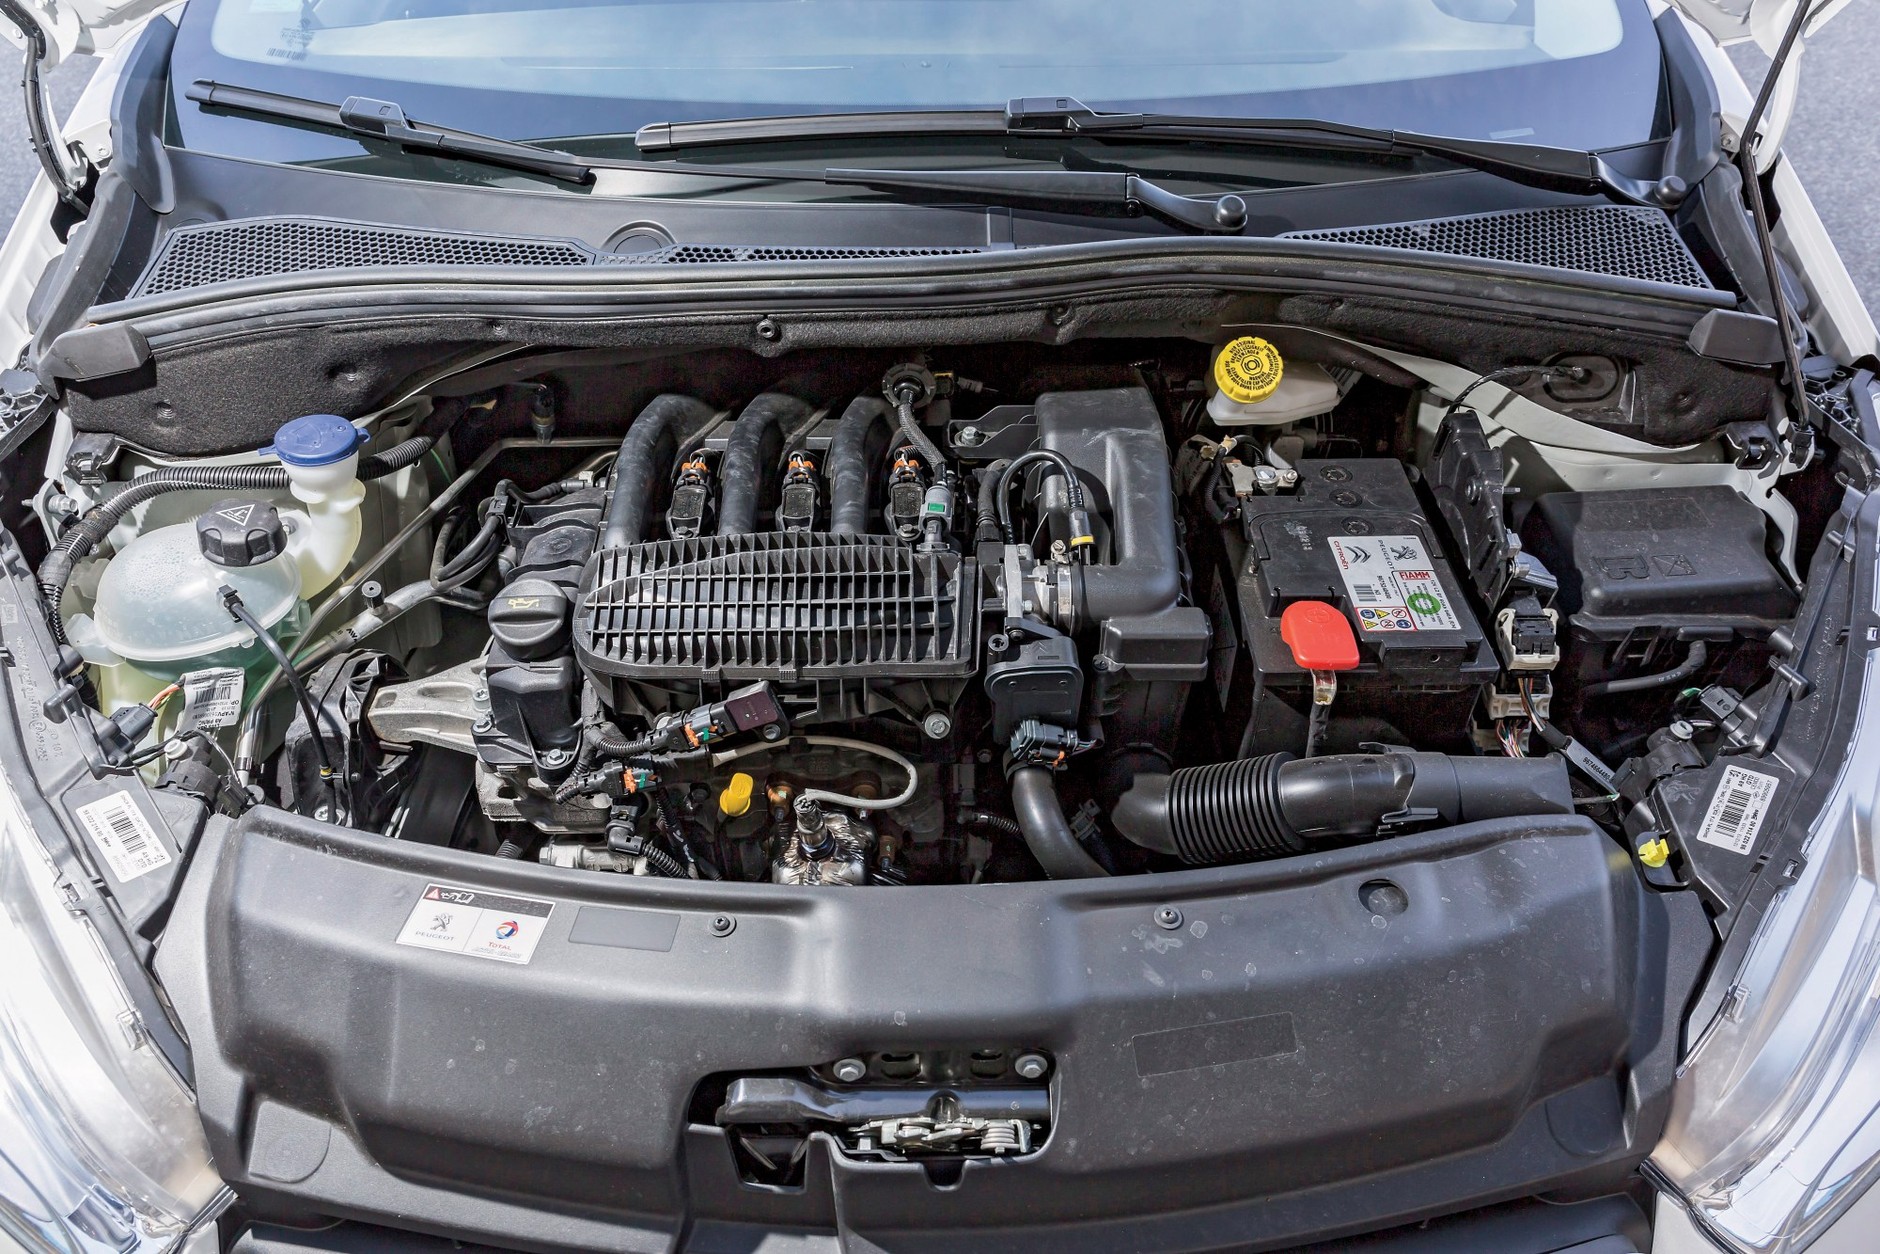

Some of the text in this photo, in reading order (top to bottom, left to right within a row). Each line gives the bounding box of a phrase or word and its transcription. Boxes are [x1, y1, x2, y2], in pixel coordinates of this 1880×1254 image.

[1249, 372, 1266, 380] WARNING
[1378, 539, 1395, 570] PEUGEOT
[1399, 571, 1431, 580] FIAMM
[415, 931, 455, 942] PEUGEOT
[488, 941, 512, 951] TOTAL
